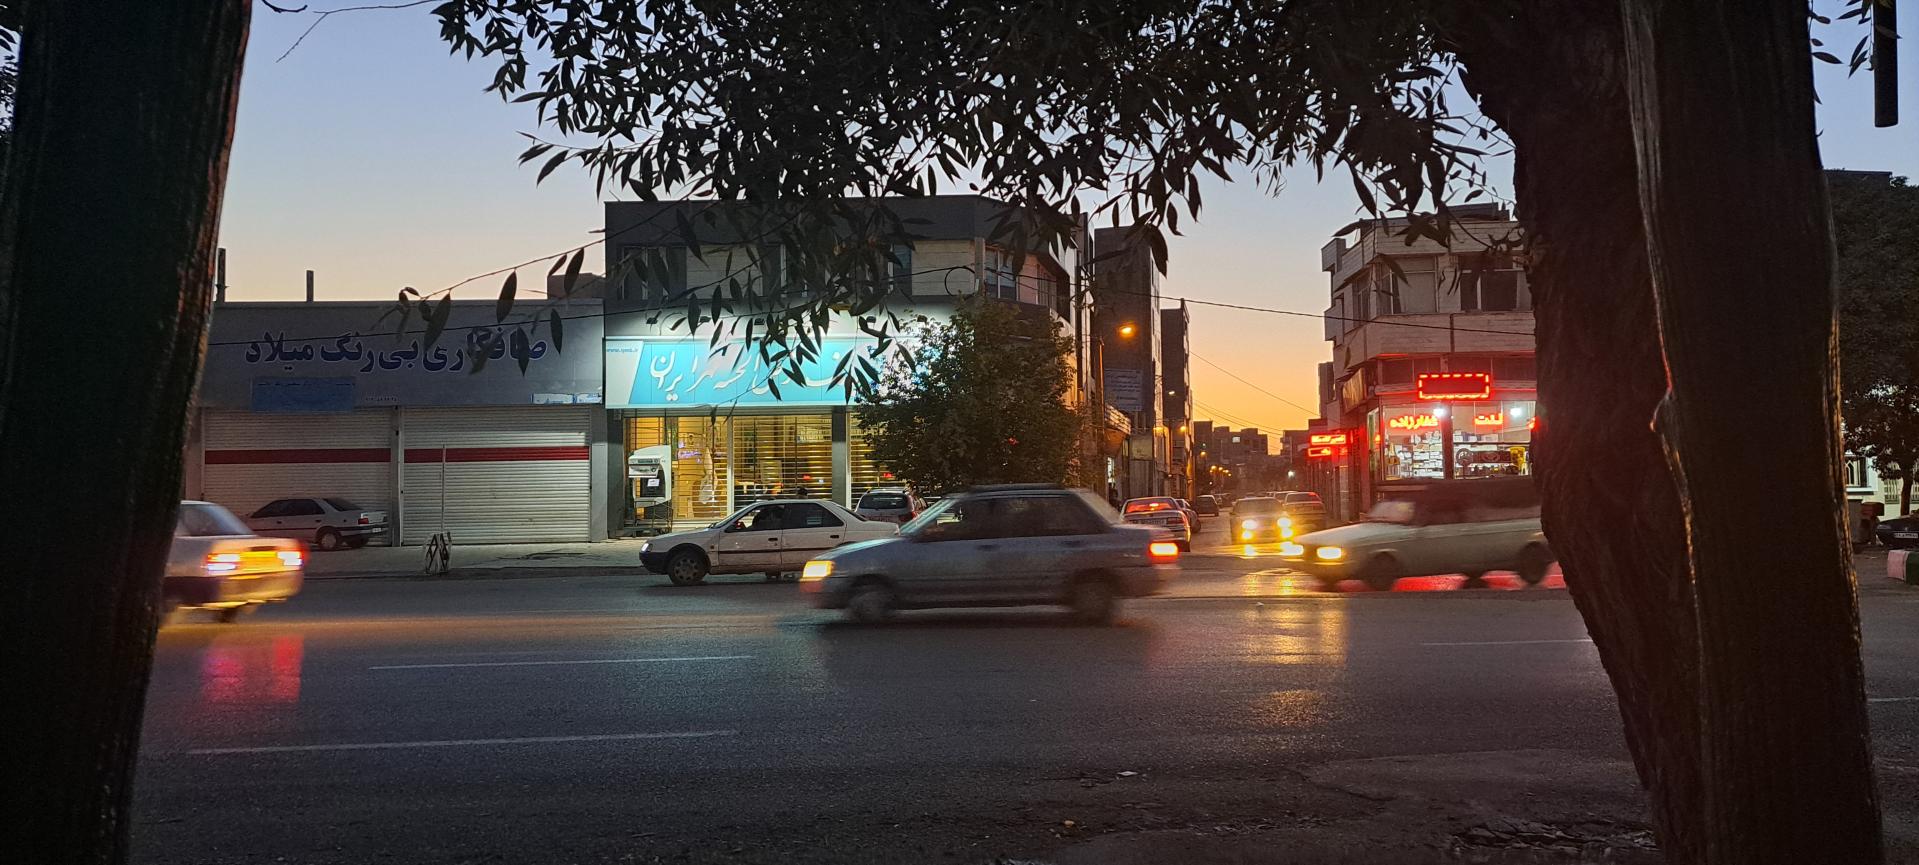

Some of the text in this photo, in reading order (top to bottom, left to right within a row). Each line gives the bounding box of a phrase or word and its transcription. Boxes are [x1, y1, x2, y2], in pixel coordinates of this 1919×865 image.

[245, 331, 315, 371] میلاد
[320, 332, 374, 373] رنگ
[378, 340, 418, 371] بی
